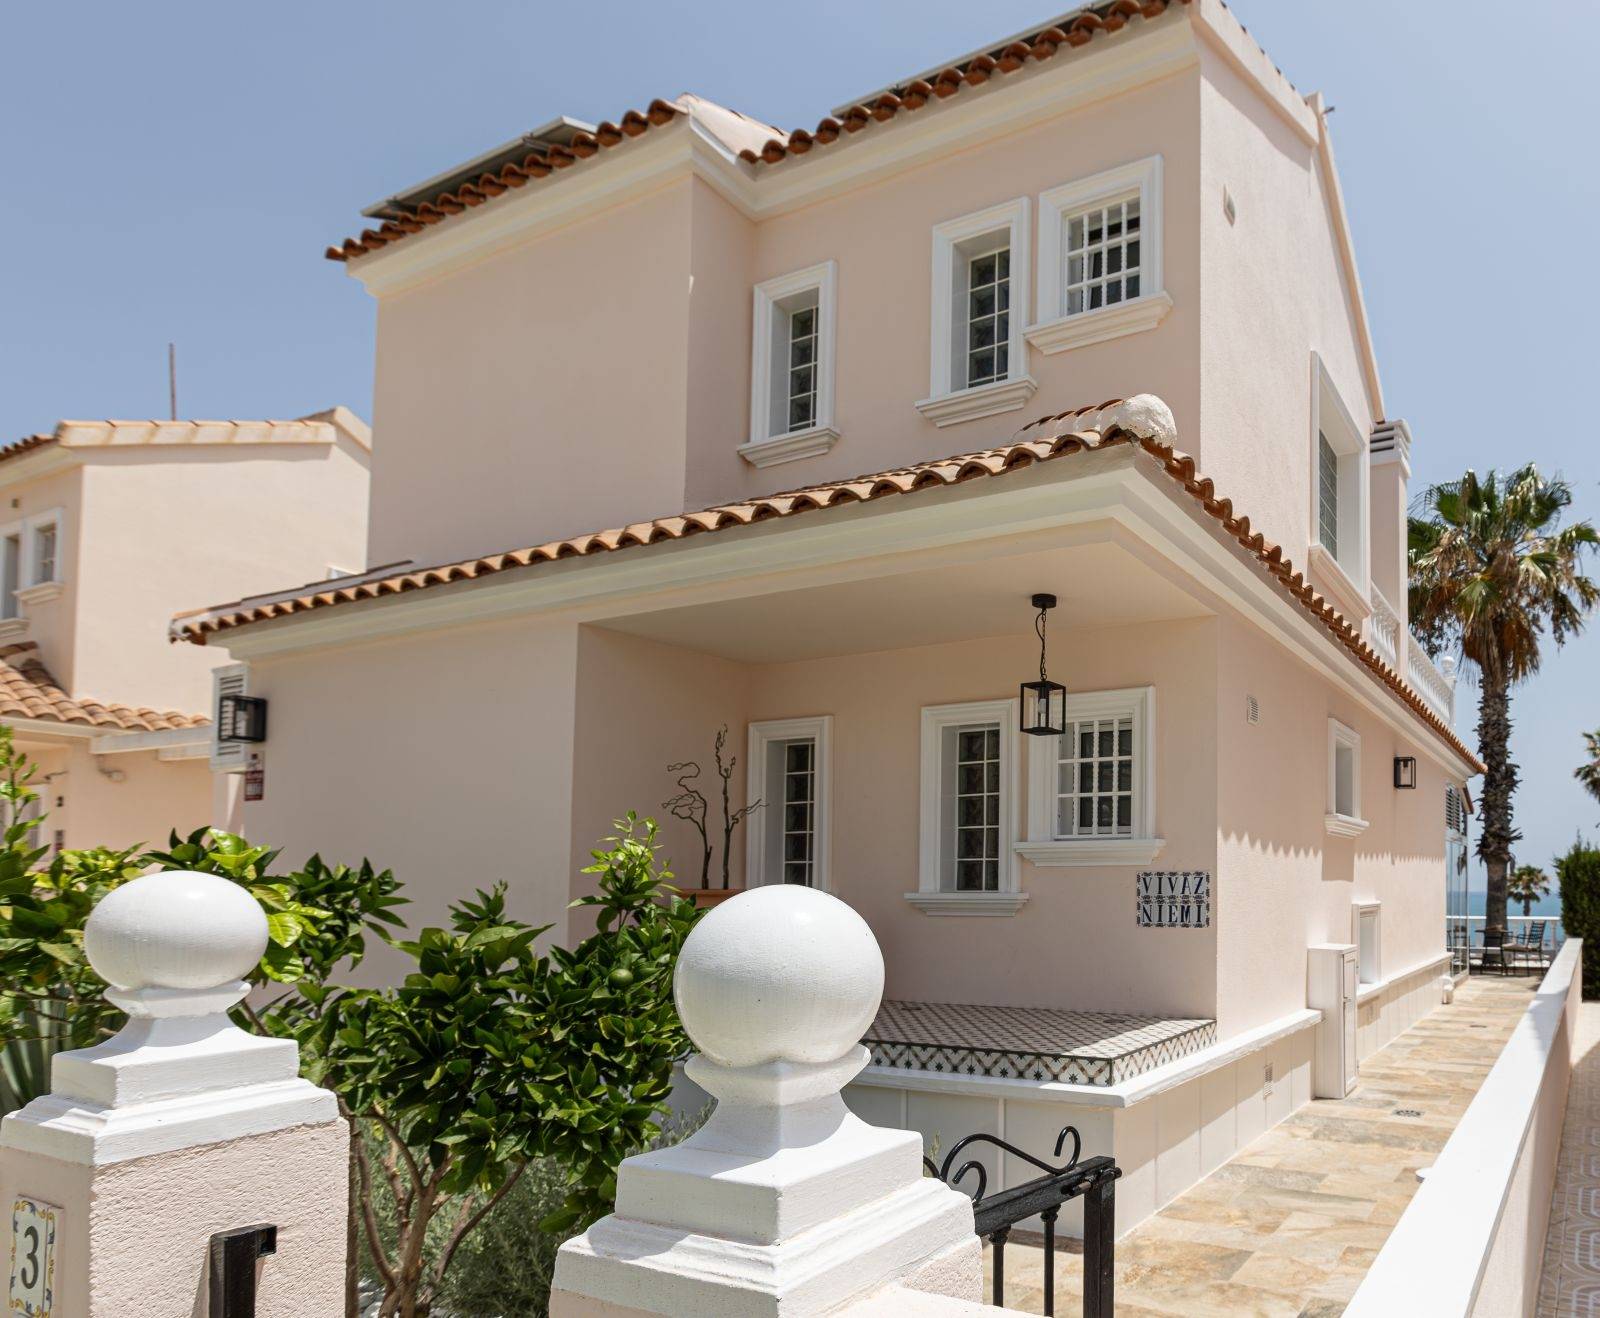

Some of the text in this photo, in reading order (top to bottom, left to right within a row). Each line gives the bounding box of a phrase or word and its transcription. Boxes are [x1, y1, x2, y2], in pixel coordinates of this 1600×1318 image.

[1142, 876, 1205, 895] VIVAZ
[1142, 904, 1202, 923] NIEMI
[21, 1225, 39, 1290] 3
